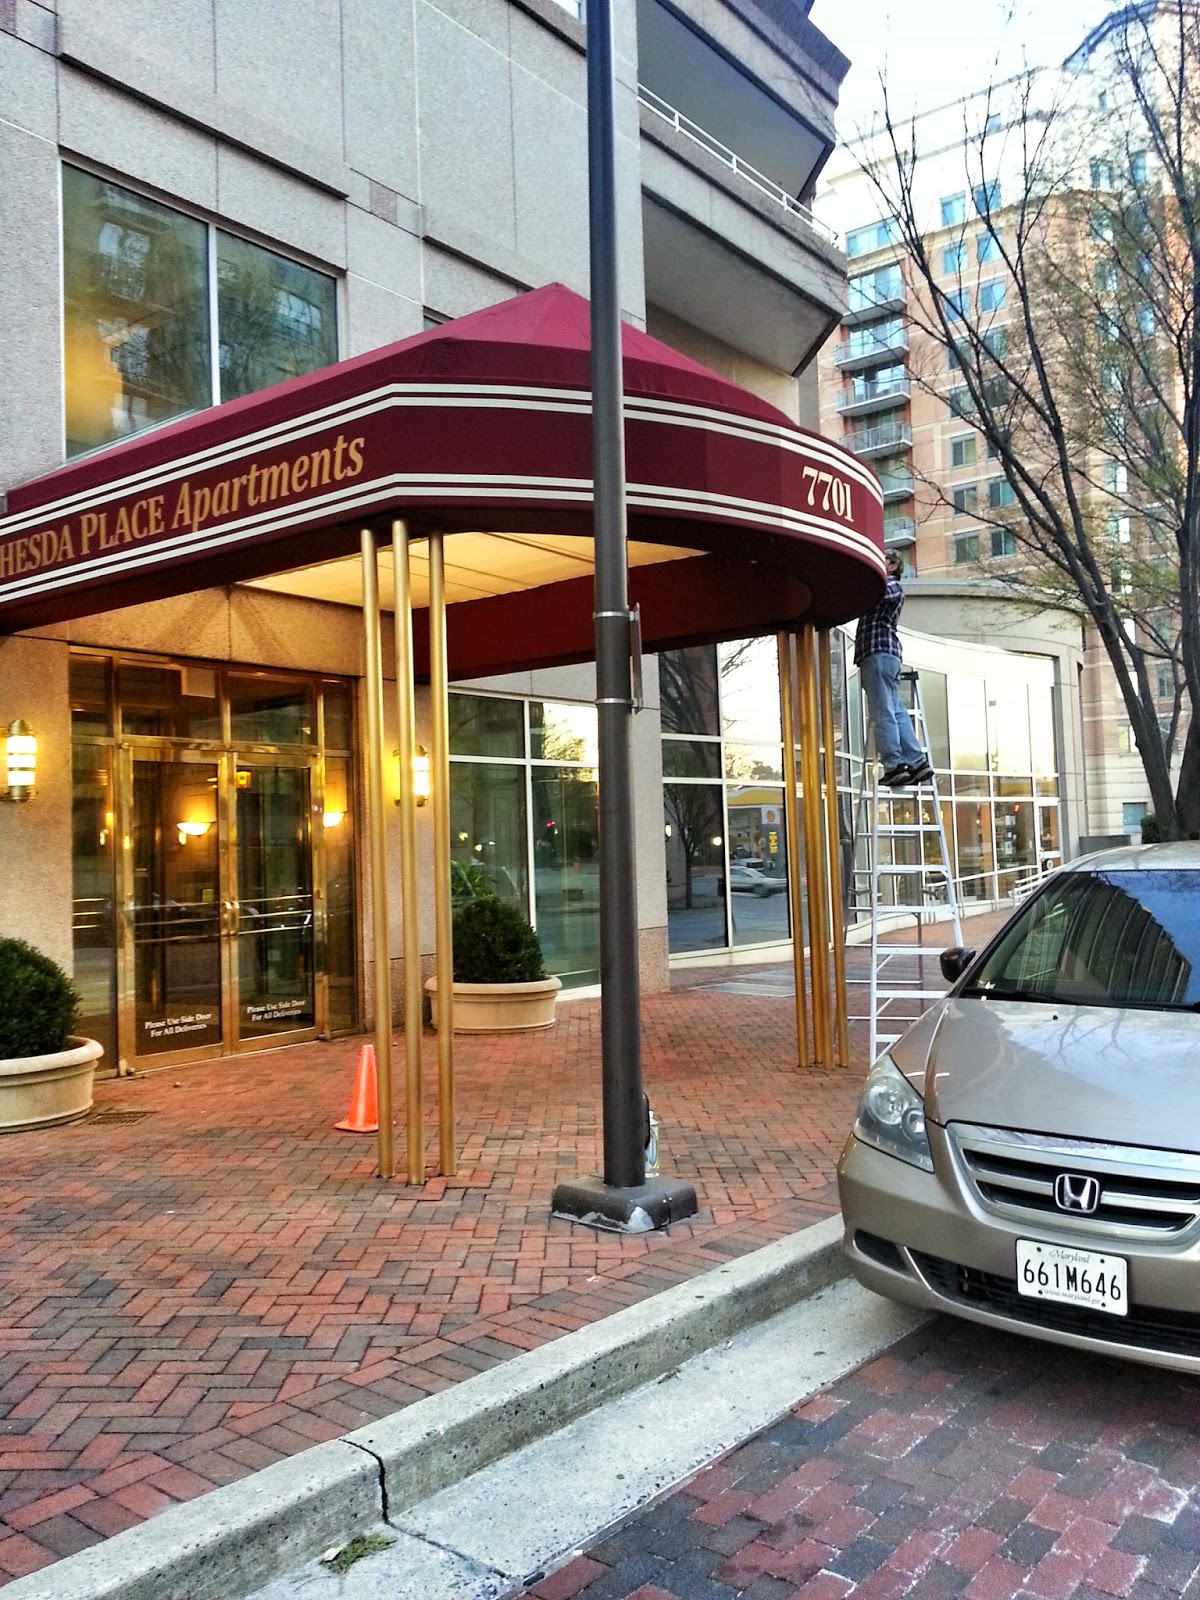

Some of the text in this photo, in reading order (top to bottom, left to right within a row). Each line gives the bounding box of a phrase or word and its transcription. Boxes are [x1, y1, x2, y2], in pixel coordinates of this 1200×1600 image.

[80, 494, 165, 556] PLACE
[170, 434, 366, 533] Apartments
[801, 465, 855, 523] 7701
[1023, 1258, 1121, 1301] 661M646
[1048, 1249, 1091, 1265] Maryland
